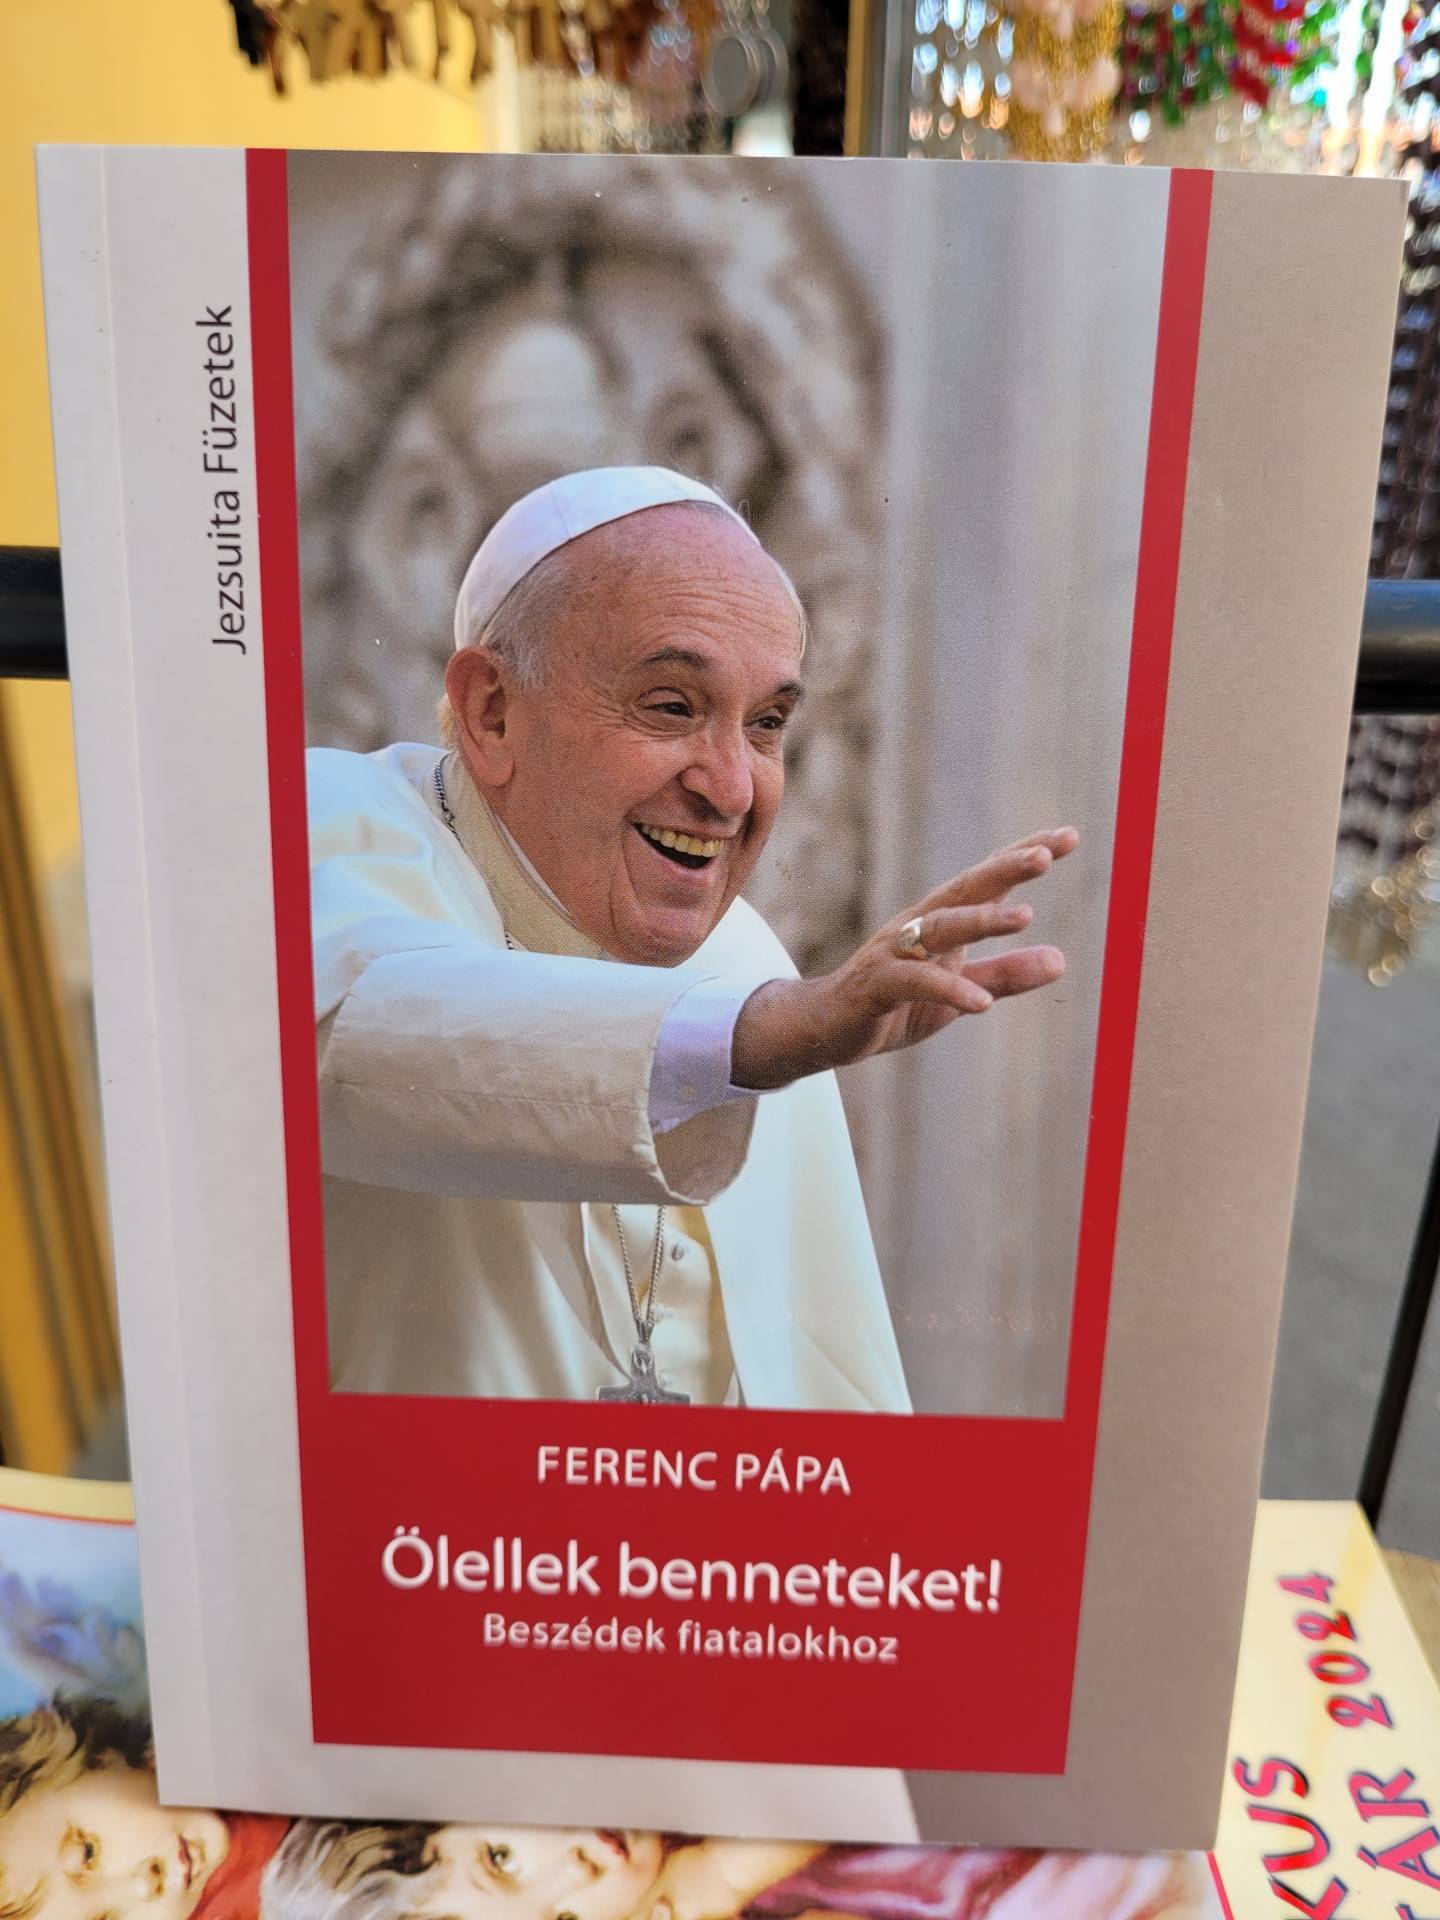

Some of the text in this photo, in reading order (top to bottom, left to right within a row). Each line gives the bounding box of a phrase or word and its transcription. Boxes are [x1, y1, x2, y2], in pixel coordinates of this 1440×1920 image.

[194, 304, 247, 655] Jezsuita Füzetek
[537, 1445, 851, 1495] FERENC PÁPA
[381, 1525, 1001, 1613] Ölellek benneteket!
[483, 1613, 898, 1664] Beszédek fiatalokhoz
[1277, 1571, 1440, 1920] ÁR 2024
